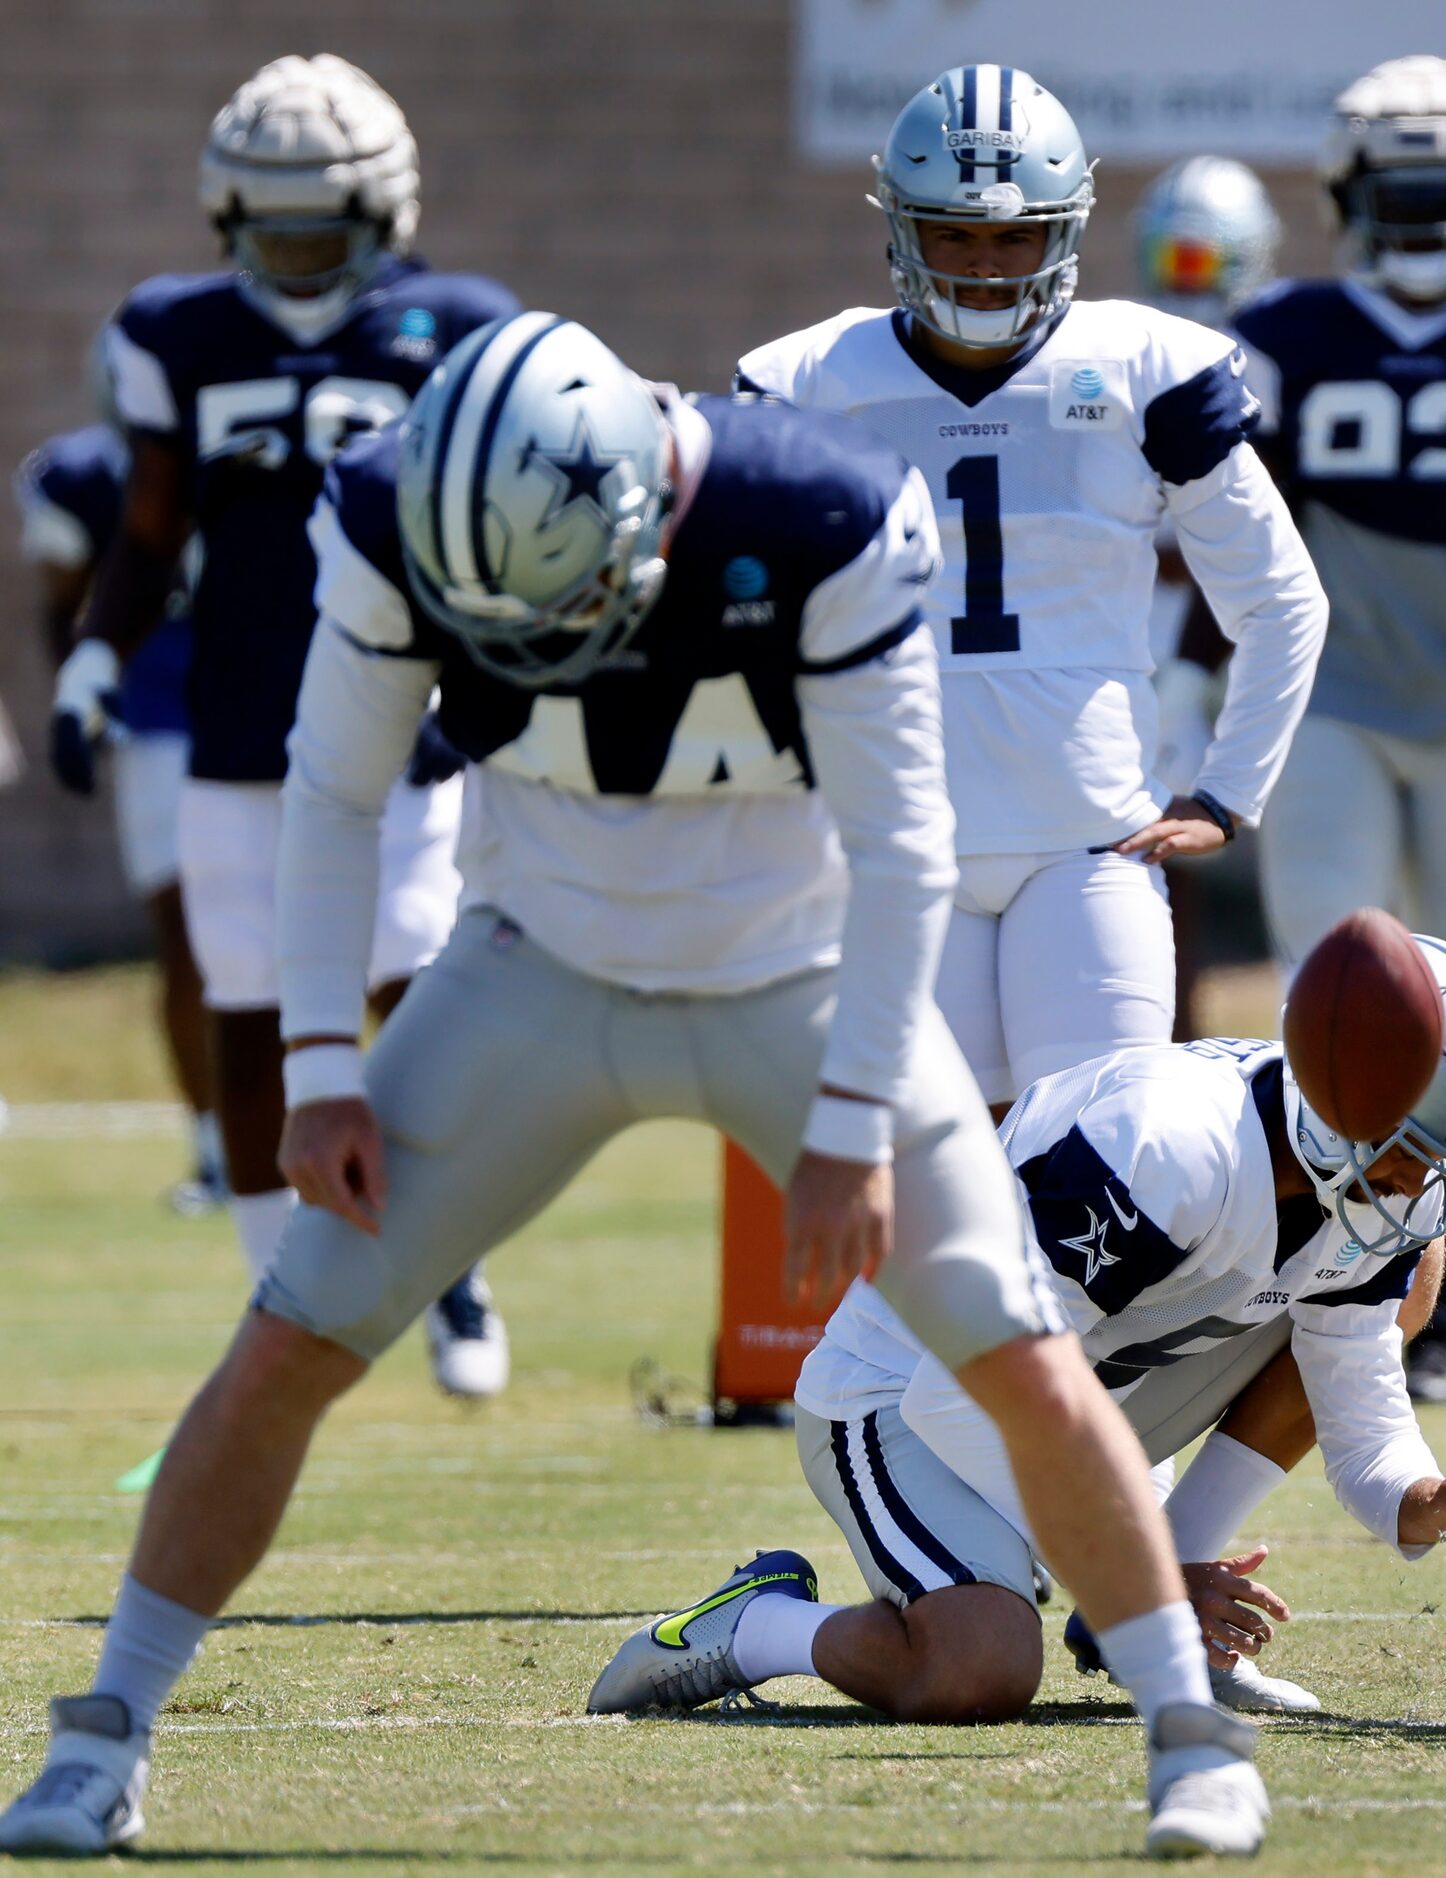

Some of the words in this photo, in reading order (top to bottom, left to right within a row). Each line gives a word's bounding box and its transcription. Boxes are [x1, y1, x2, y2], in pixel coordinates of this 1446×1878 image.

[947, 132, 1024, 149] GARIBAY
[1066, 405, 1108, 420] AT&T
[939, 423, 1009, 438] COWBOYS
[946, 454, 1021, 655] 1
[1314, 1268, 1347, 1280] AT&T
